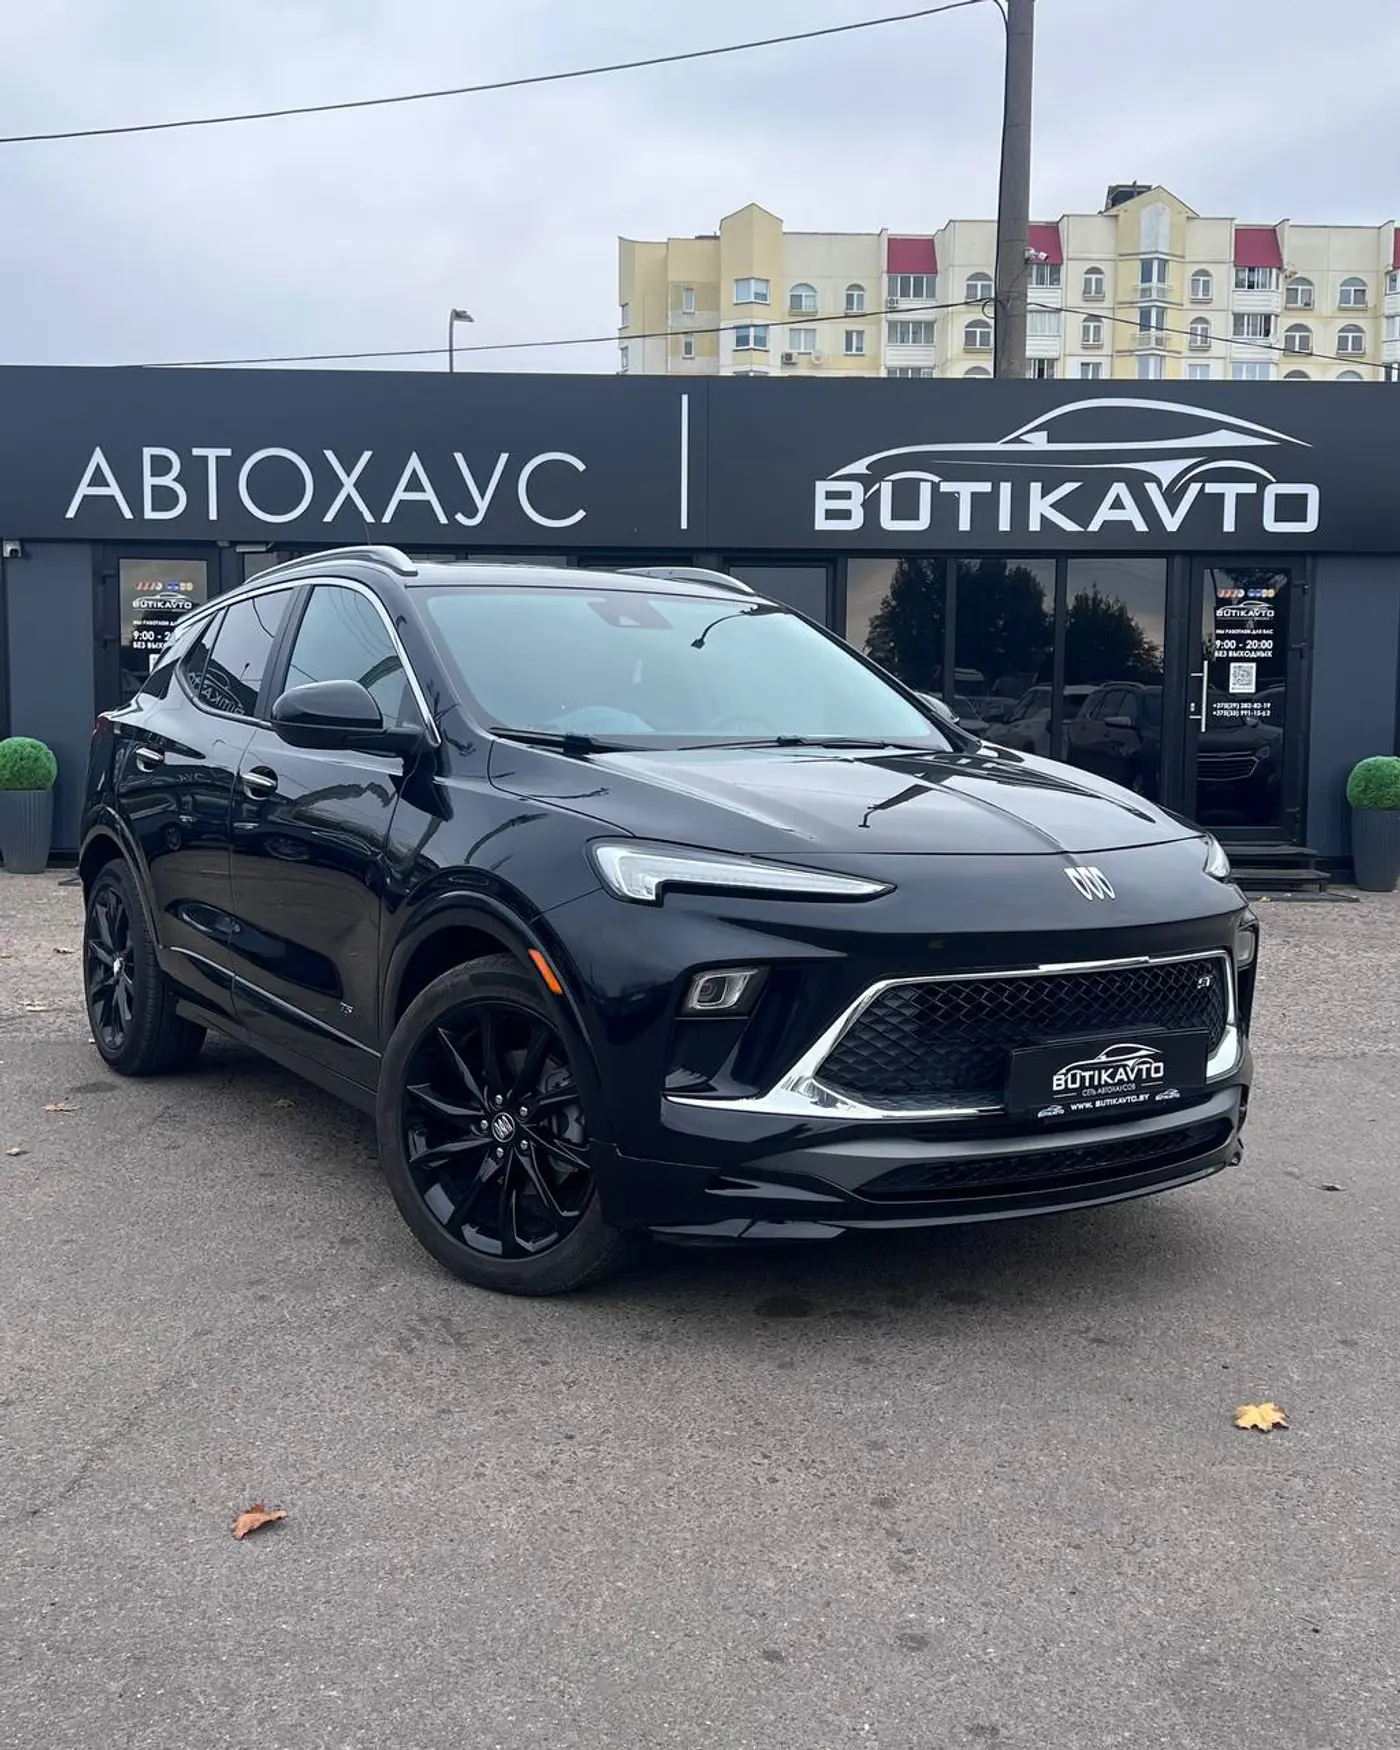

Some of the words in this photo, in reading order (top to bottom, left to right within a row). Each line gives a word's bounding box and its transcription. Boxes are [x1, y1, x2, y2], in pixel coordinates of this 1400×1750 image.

[65, 446, 587, 528] АВТОХАУС
[814, 479, 1320, 533] BUTIKAVTO
[132, 600, 192, 609] BUTIKAVTO
[1215, 608, 1275, 617] BUTIKAVTO
[132, 630, 156, 641] 9:00
[1215, 639, 1237, 650] 9:00
[1245, 639, 1274, 650] 20:00
[1228, 650, 1273, 659] ВЫХОДНЫХ
[1052, 1062, 1164, 1091] BUTIKAVTO
